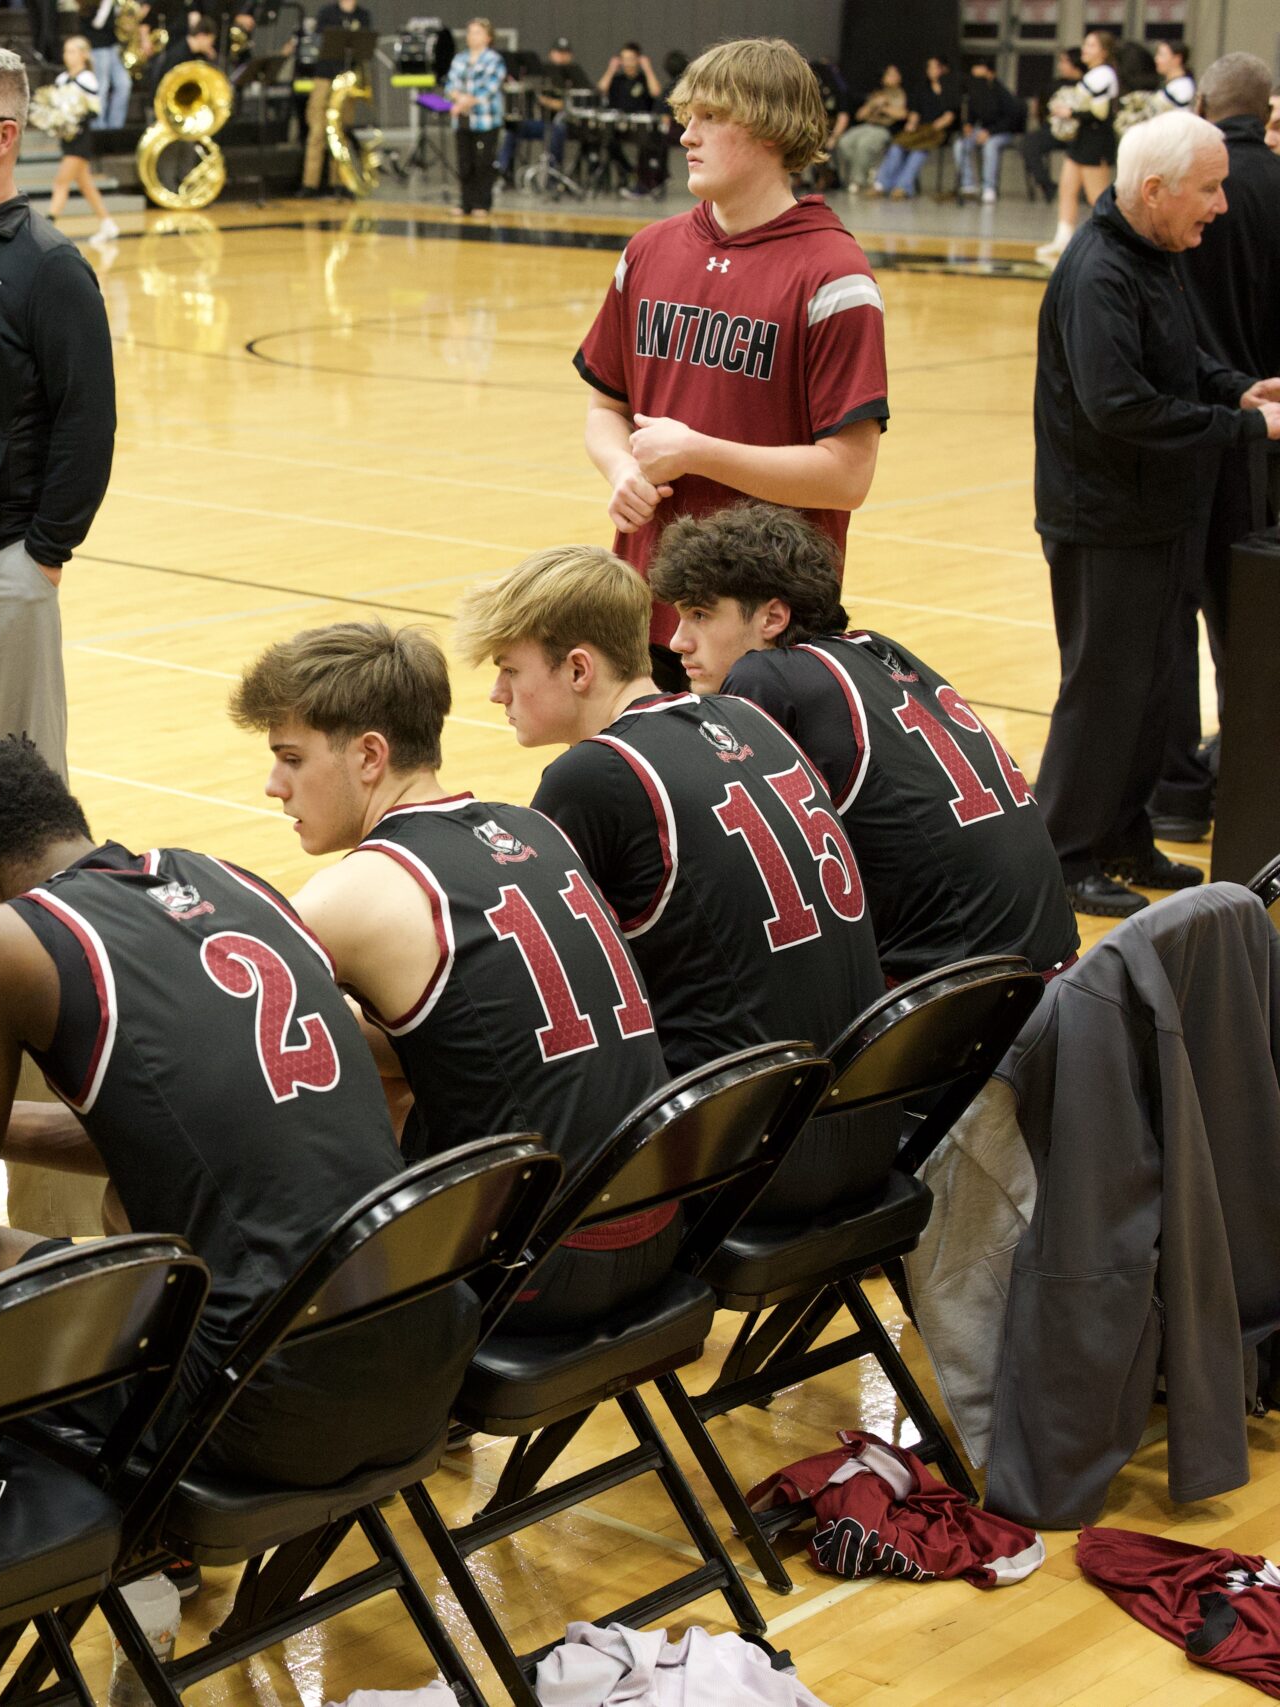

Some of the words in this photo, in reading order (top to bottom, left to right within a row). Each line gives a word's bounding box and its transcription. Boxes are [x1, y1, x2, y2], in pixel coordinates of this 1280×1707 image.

[636, 299, 779, 381] ANTIOCH
[711, 760, 865, 953] 15
[200, 931, 341, 1104] 2
[483, 869, 655, 1063] 11
